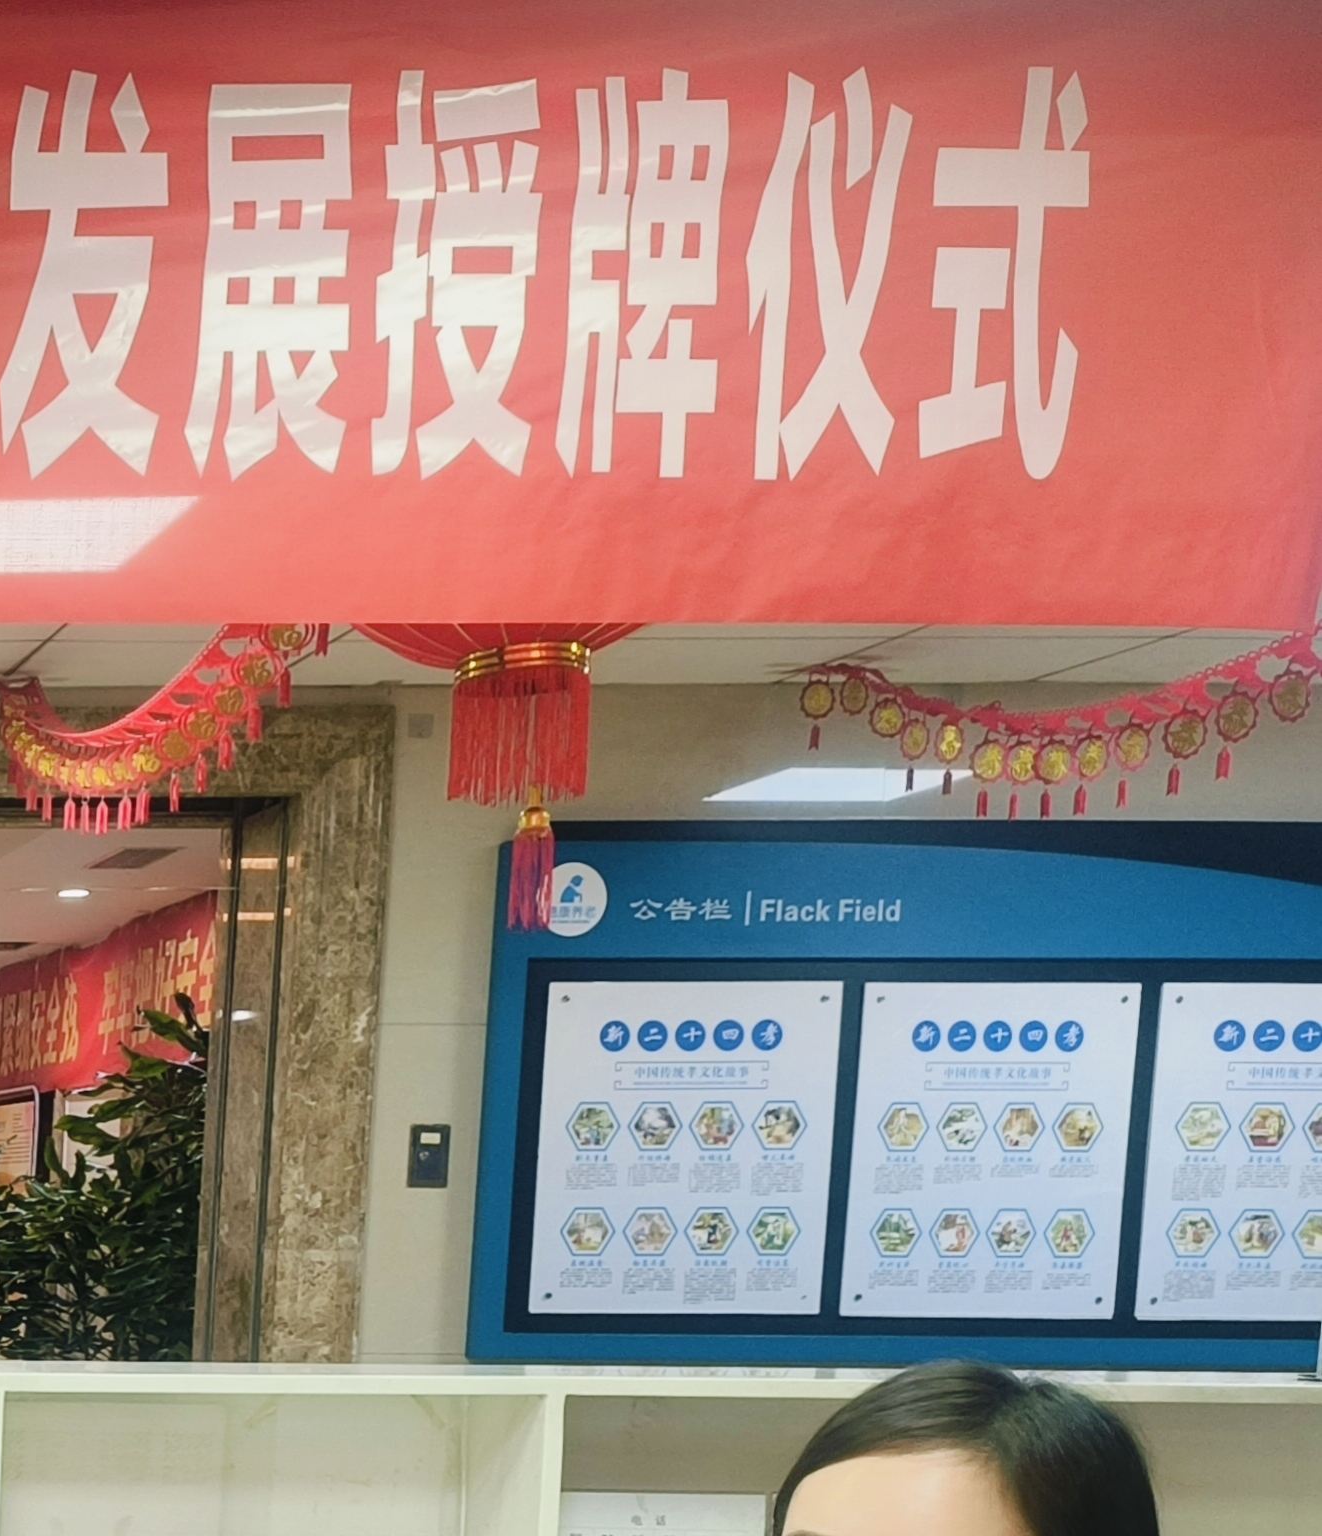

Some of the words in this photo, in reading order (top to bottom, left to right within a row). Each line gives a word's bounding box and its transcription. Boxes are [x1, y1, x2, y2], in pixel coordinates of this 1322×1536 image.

[629, 896, 732, 924] 公告栏
[759, 898, 830, 923] Flack
[838, 898, 901, 923] Field
